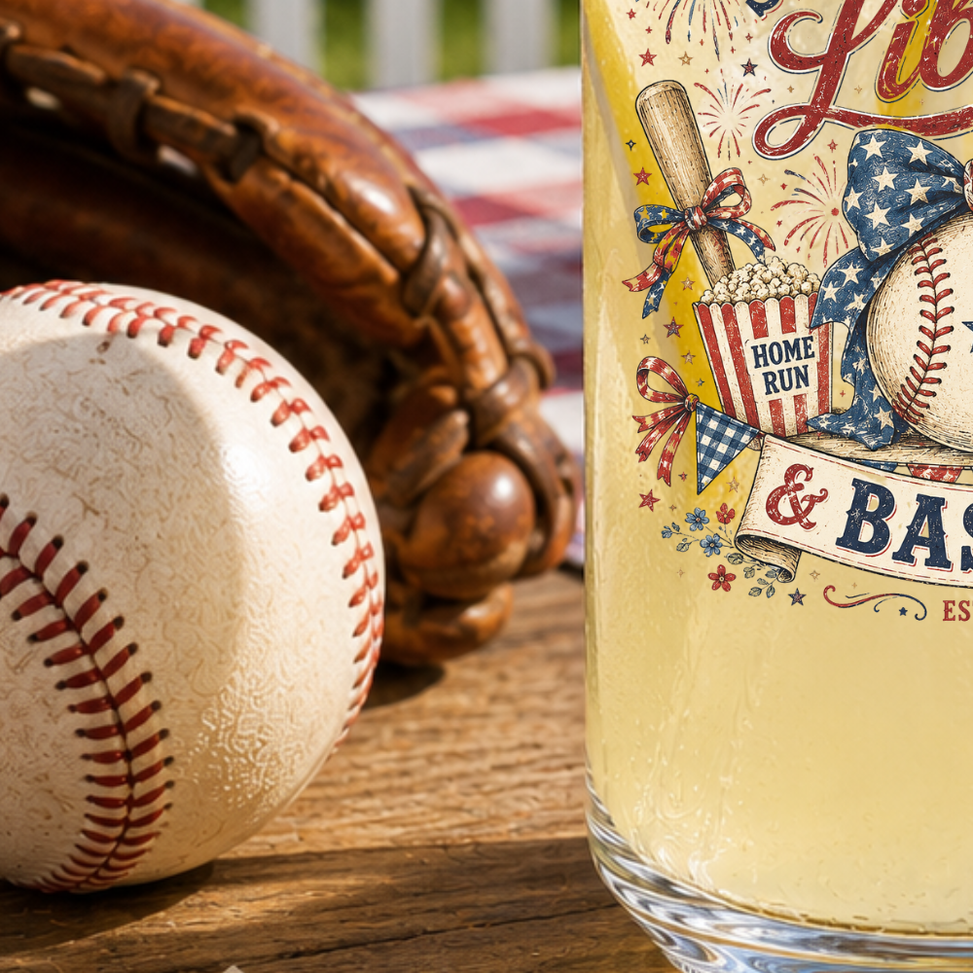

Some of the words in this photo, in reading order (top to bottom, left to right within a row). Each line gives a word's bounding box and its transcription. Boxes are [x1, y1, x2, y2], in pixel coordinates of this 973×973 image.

[750, 336, 816, 369] HOME
[763, 366, 811, 398] RUN
[764, 463, 829, 533] &
